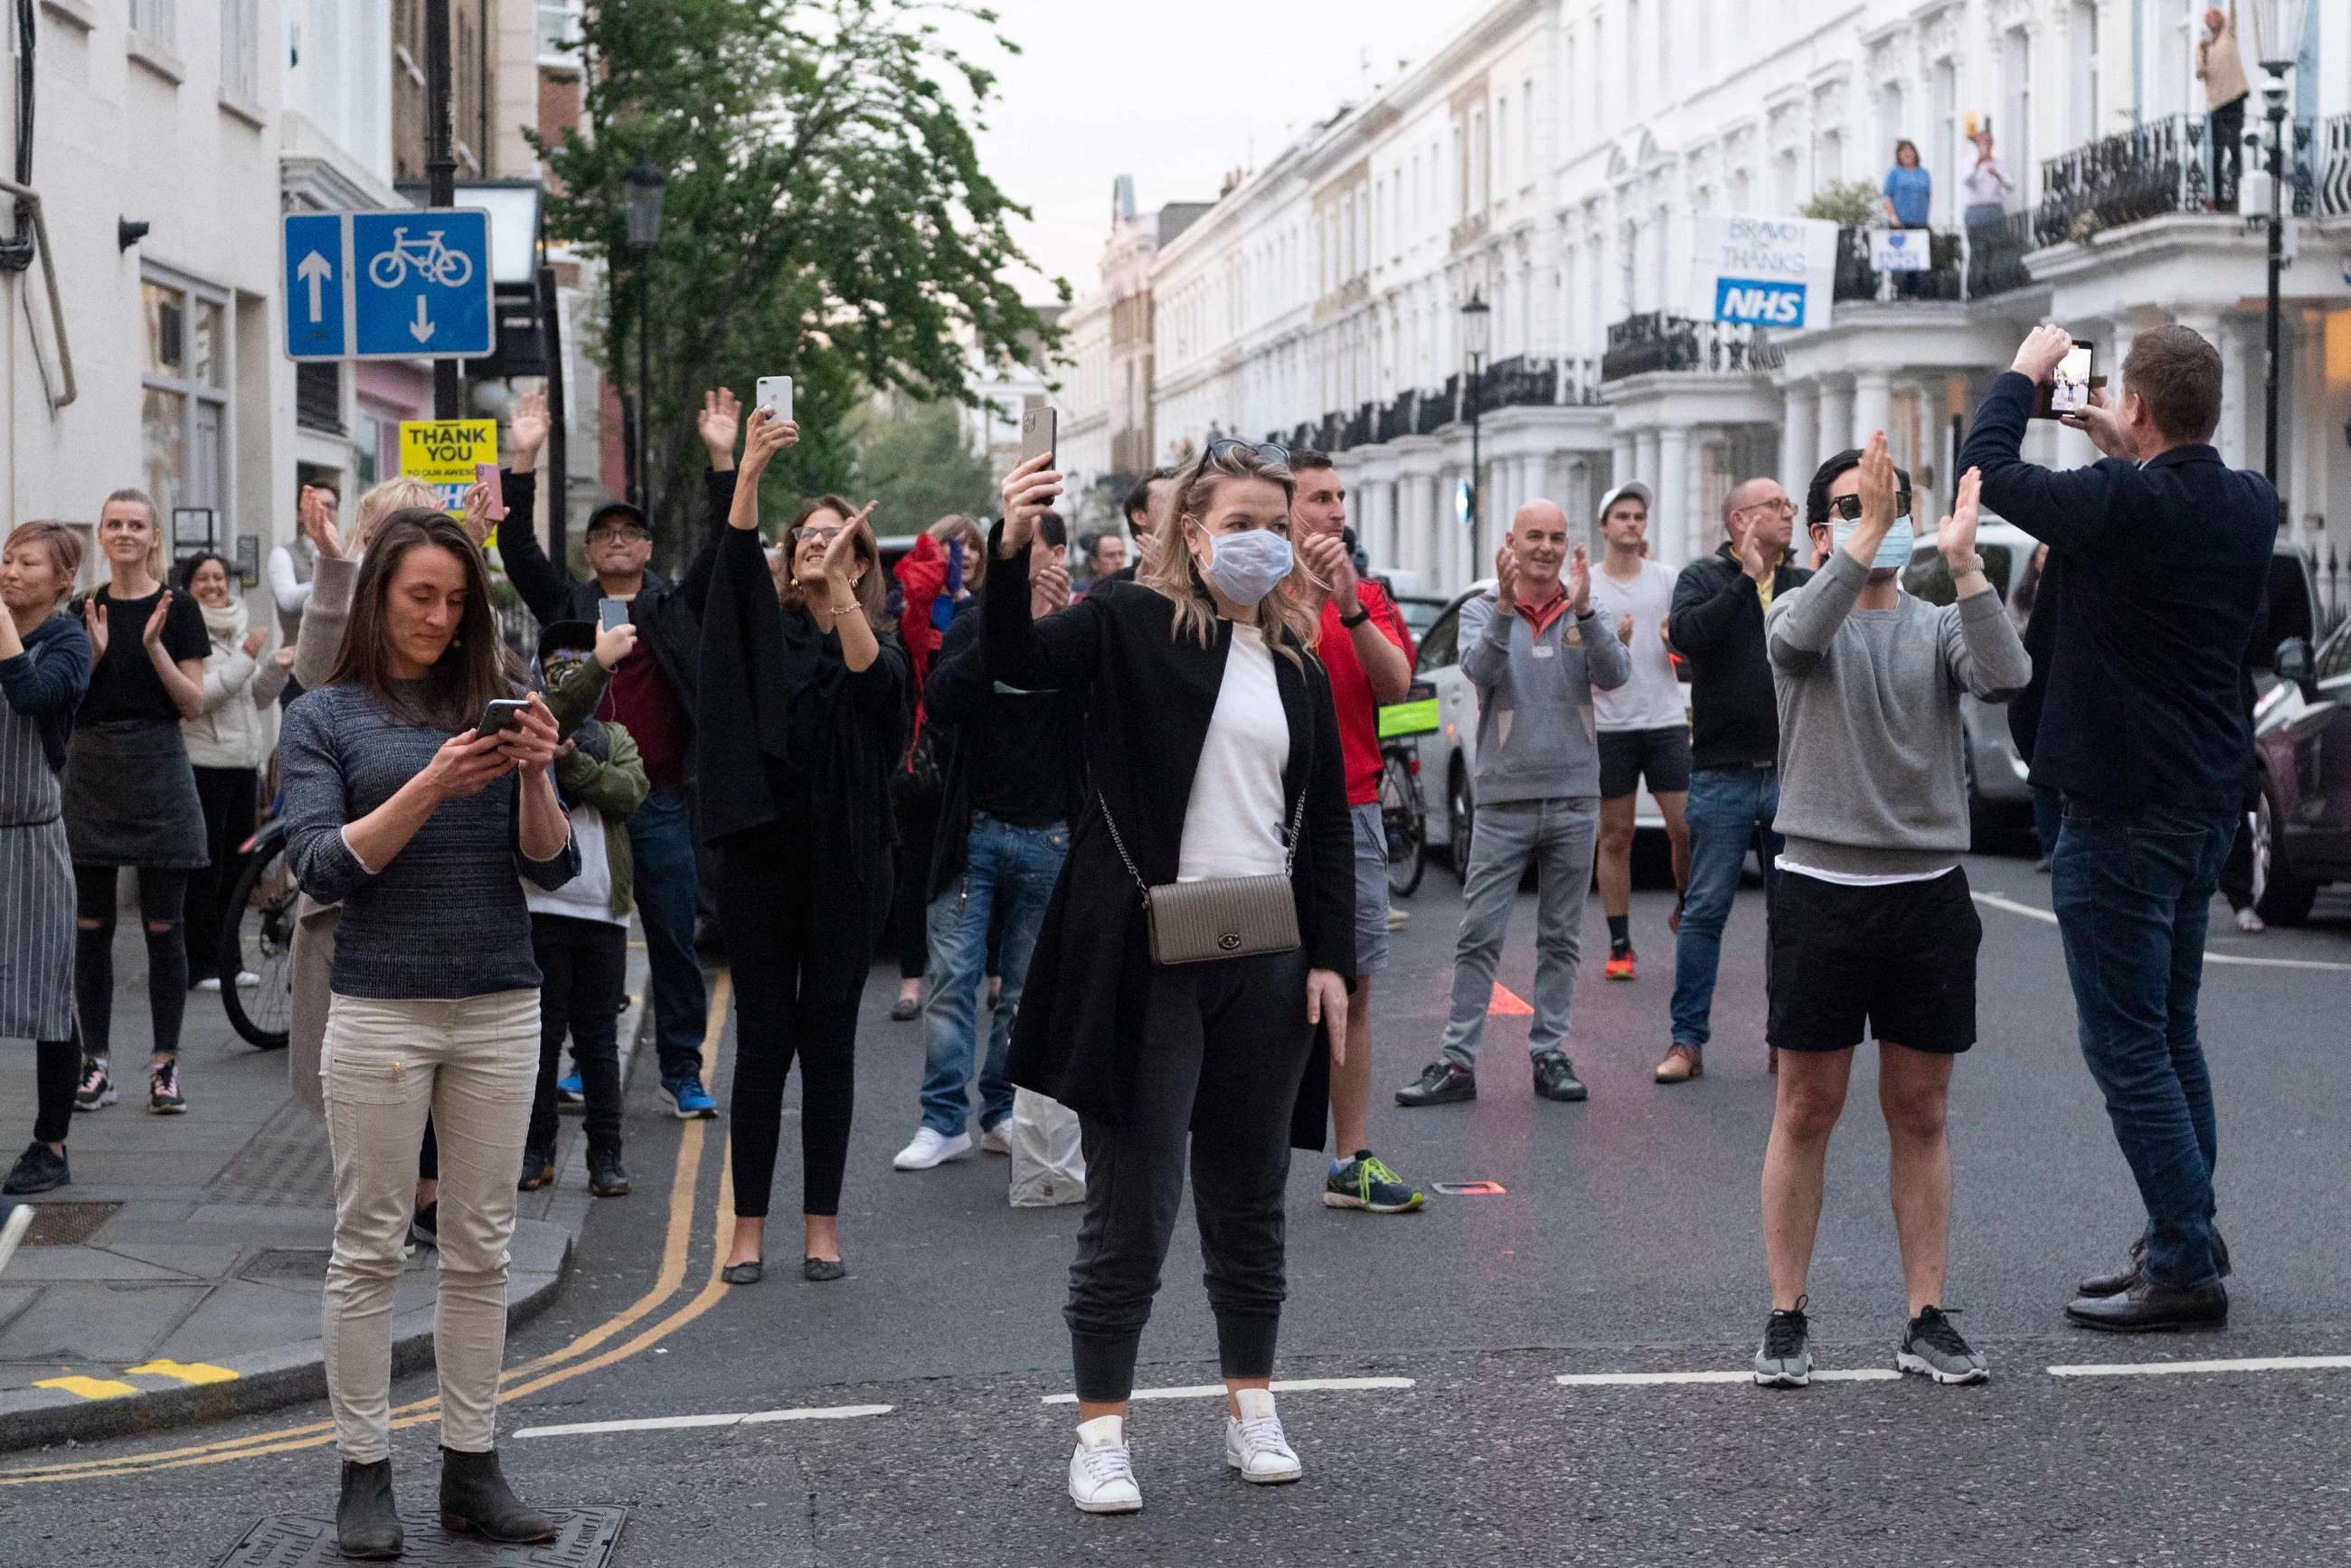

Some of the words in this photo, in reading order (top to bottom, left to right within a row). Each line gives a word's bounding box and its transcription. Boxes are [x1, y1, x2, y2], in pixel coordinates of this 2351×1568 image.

[1722, 245, 1807, 275] THANKS
[1723, 287, 1801, 323] NHS
[409, 428, 486, 445] THANK
[427, 445, 472, 462] YOU
